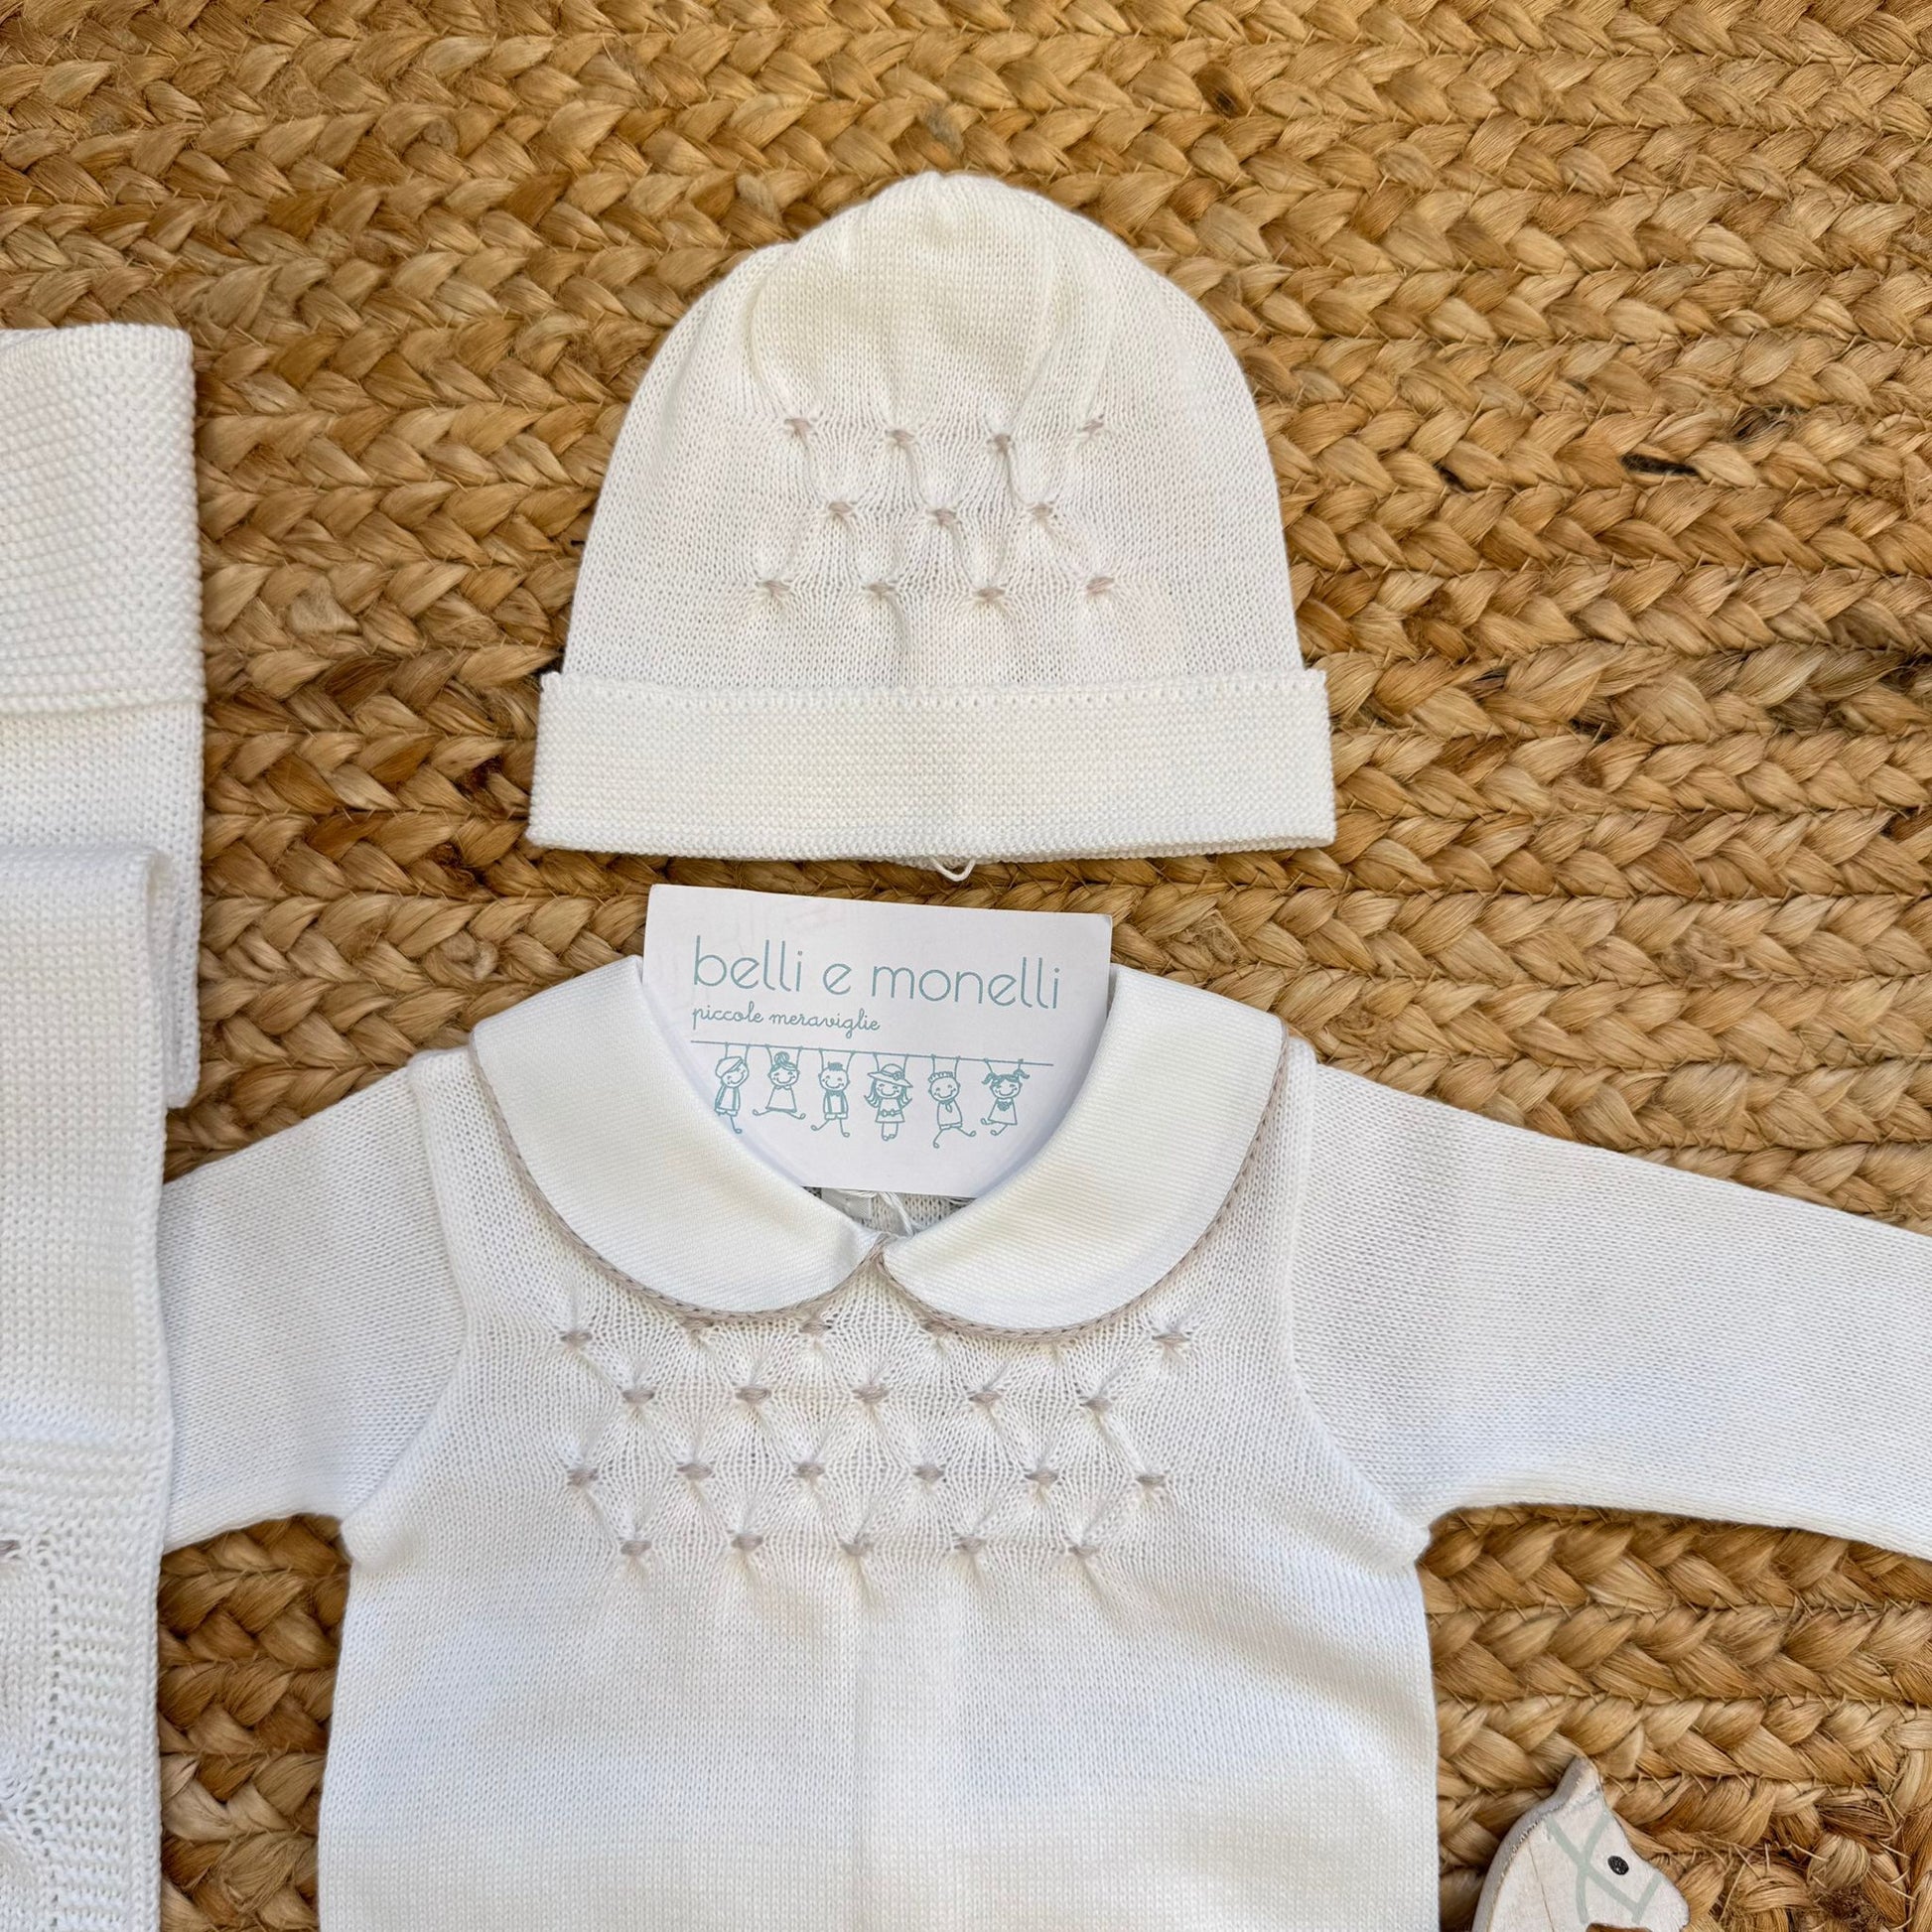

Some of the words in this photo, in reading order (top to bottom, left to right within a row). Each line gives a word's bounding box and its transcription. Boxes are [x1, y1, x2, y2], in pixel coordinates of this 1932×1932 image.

[694, 935, 803, 992] belli
[822, 964, 852, 995] e
[871, 957, 1060, 1010] monelli
[692, 1001, 764, 1031] piccole
[768, 1008, 882, 1039] meraviglie
